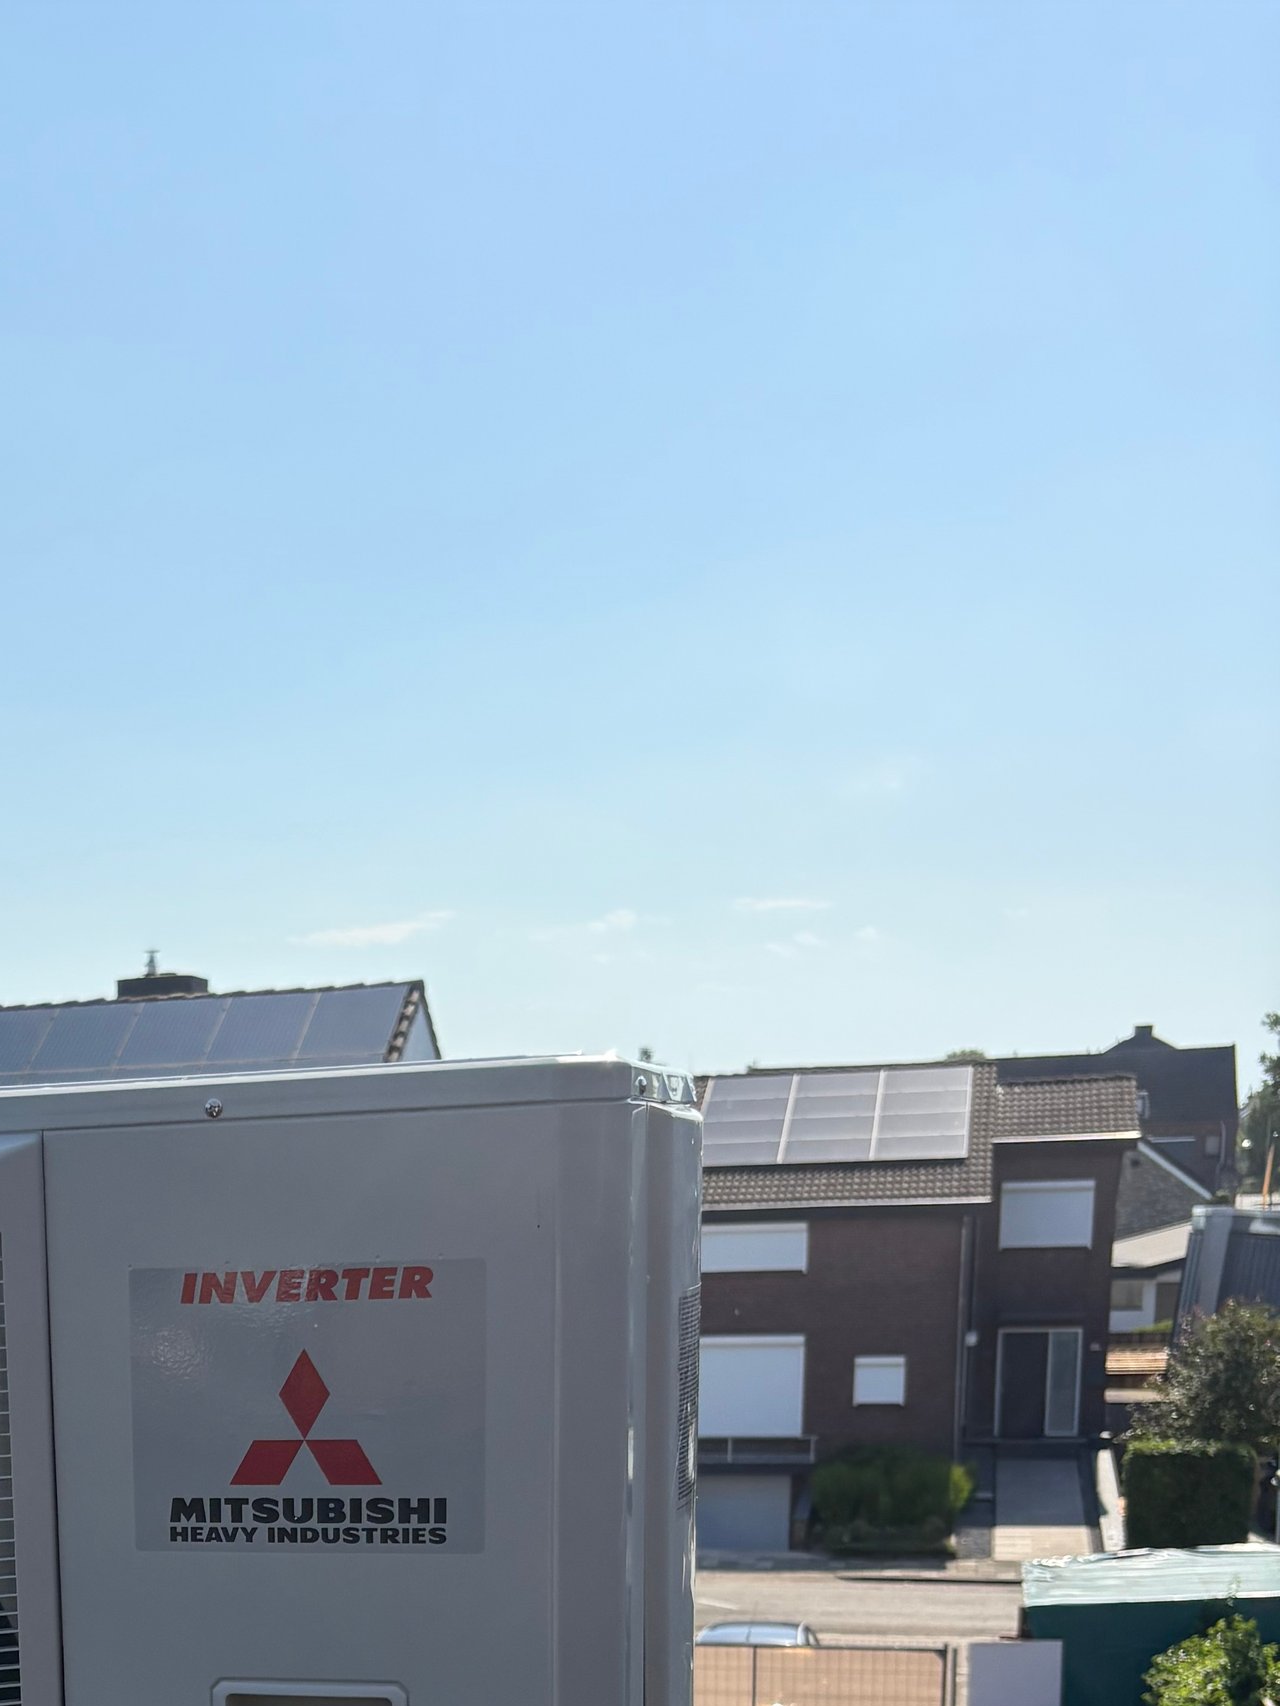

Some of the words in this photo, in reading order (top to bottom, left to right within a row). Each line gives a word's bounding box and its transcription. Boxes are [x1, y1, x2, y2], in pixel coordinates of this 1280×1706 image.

[180, 1265, 434, 1304] INVERTER
[169, 1496, 447, 1524] MITSUBISHI
[169, 1526, 259, 1543] HEAVY
[267, 1526, 447, 1544] INDUSTRIES
